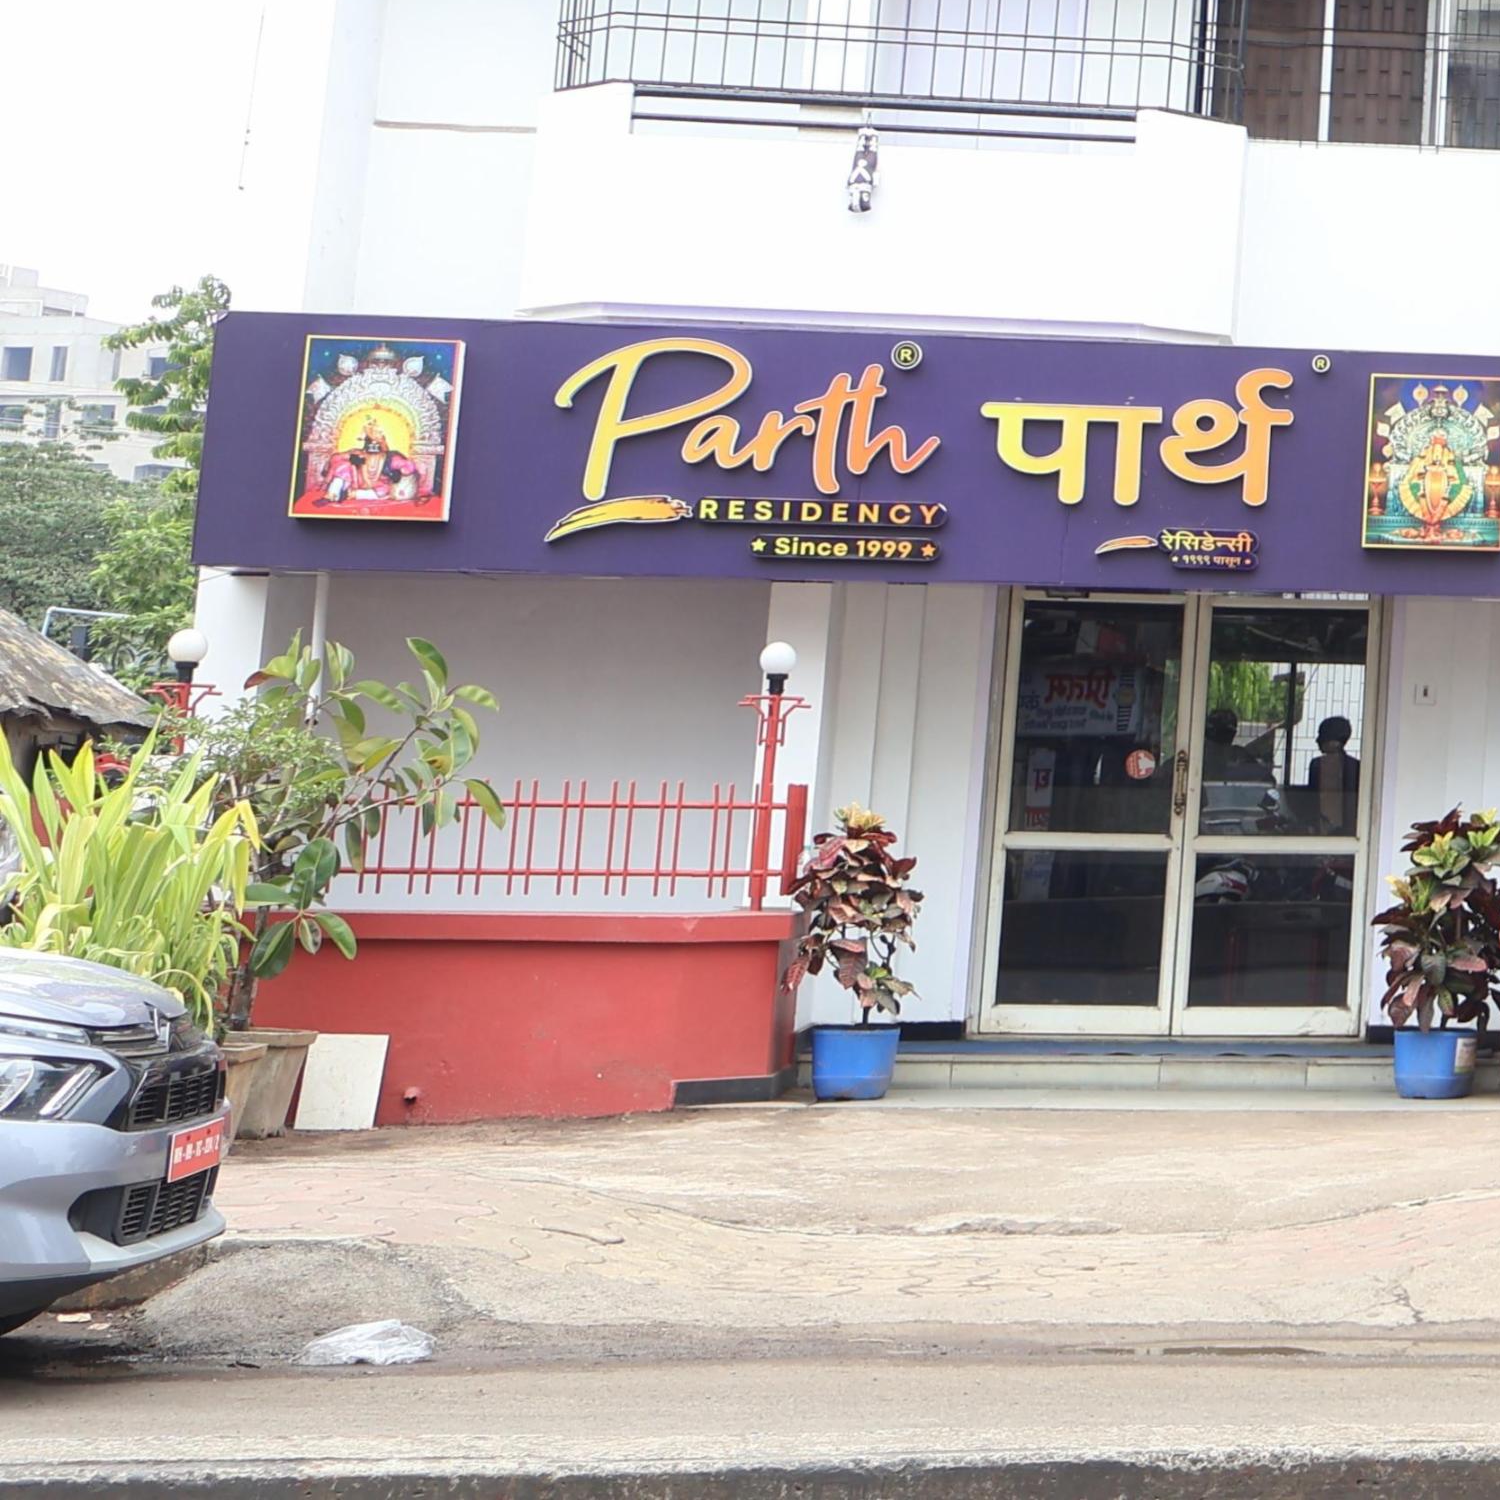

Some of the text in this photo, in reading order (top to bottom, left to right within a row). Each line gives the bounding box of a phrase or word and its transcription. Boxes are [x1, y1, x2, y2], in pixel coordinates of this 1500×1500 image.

[555, 337, 941, 501] Parth
[980, 369, 1294, 506] पार्थ
[700, 498, 942, 526] RESIDENCY
[775, 536, 913, 560] Since 1999
[1160, 528, 1254, 553] रेसिडेन्सी
